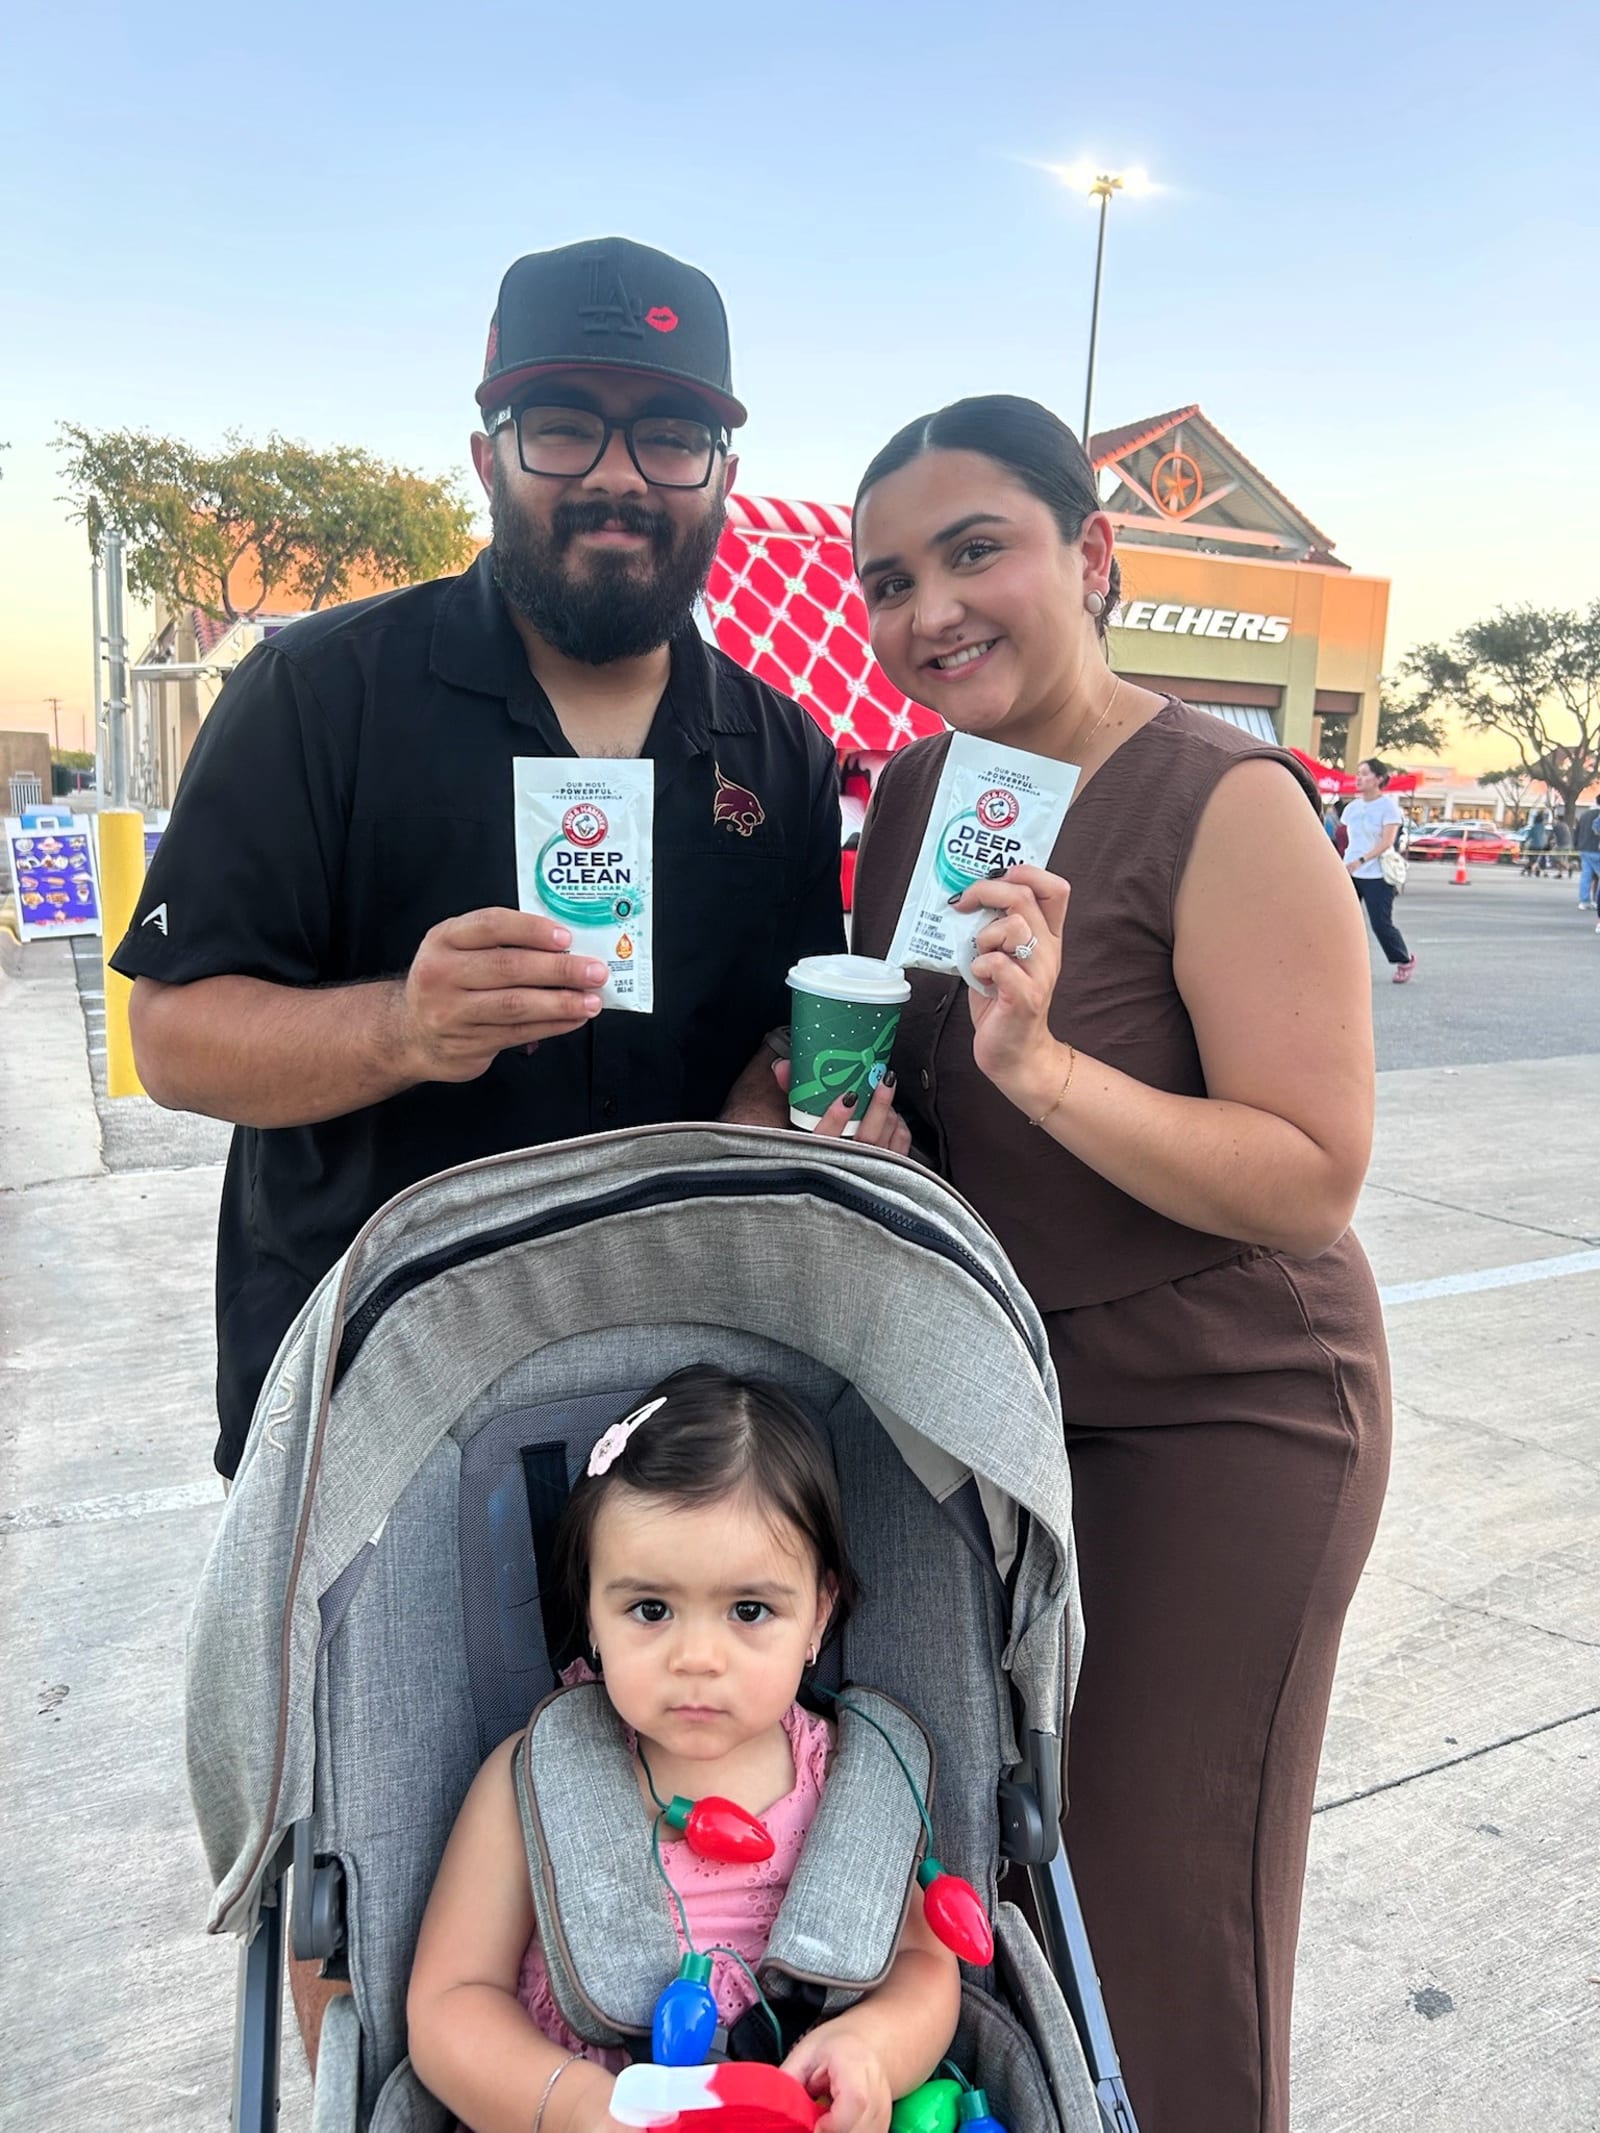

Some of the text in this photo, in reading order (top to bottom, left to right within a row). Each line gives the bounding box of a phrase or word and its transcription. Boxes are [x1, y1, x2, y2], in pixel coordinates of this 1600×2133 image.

[578, 256, 644, 340] LA
[1107, 600, 1293, 643] KECHERS
[987, 770, 1033, 789] POWERFUL
[1011, 771, 1030, 781] MOST
[959, 825, 1021, 852] DEEP
[556, 851, 624, 867] DEEP
[947, 839, 1024, 868] CLEAN
[548, 868, 631, 884] CLEAN
